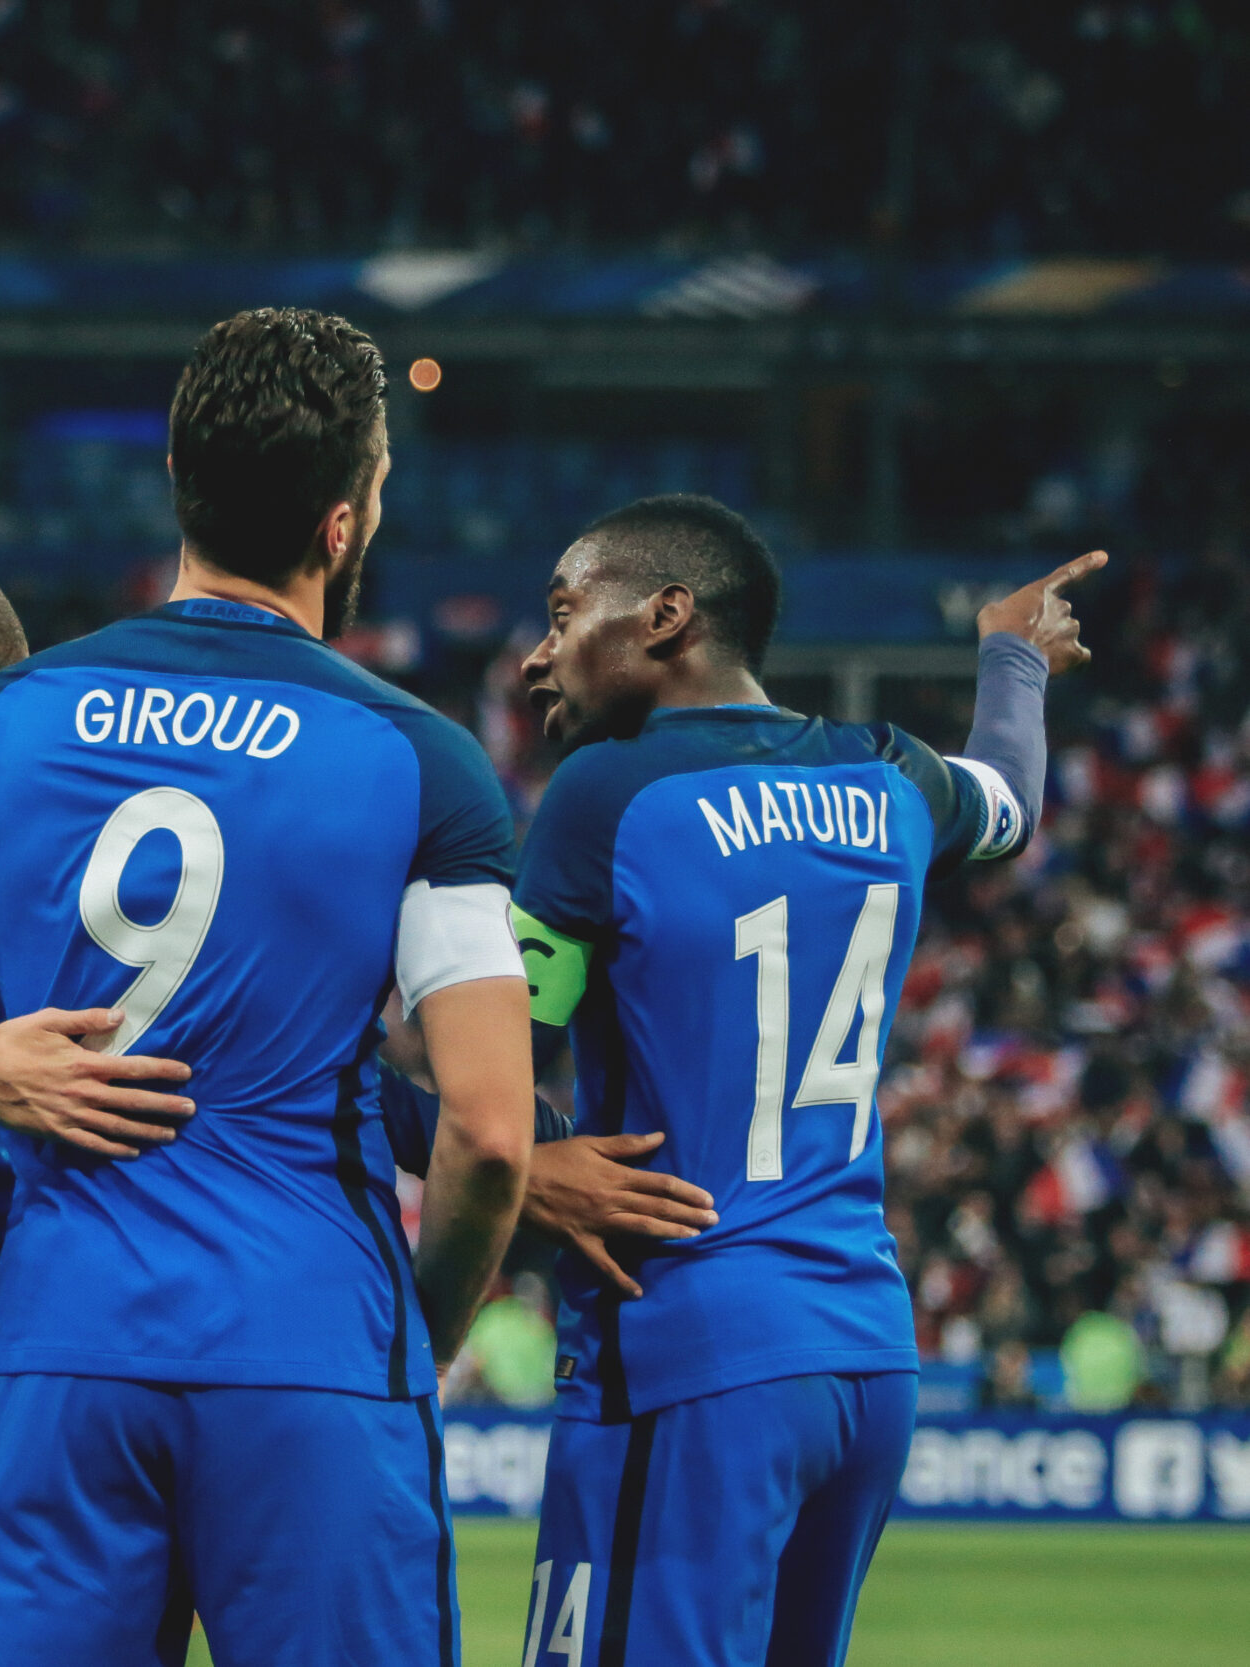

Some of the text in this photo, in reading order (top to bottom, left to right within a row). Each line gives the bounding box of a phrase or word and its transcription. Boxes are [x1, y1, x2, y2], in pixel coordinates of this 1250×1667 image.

[190, 604, 267, 623] FRANCE
[75, 687, 301, 760] GIROUD
[696, 781, 888, 858] MATUIDI
[78, 786, 225, 1057] 9
[734, 882, 900, 1182] 14
[523, 1559, 592, 1667] 14
